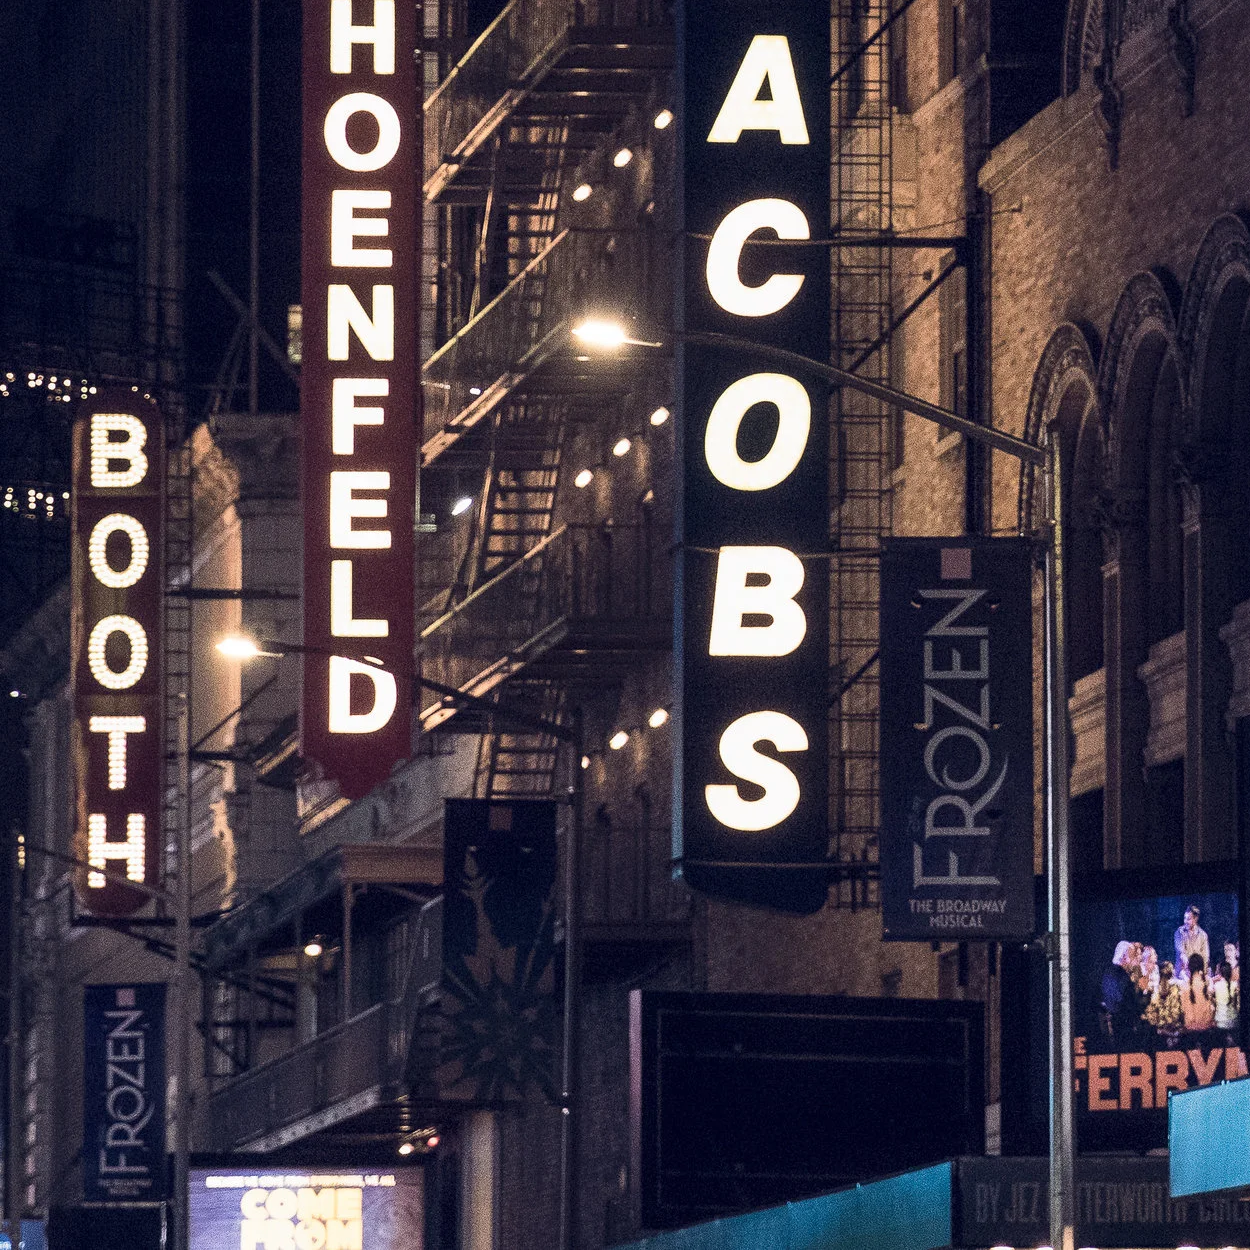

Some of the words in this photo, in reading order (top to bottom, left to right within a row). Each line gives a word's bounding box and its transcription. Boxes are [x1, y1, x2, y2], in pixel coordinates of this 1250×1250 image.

[86, 413, 149, 889] BOOTH
[912, 588, 1009, 890] FROZEN
[908, 898, 934, 914] THE
[936, 898, 1008, 914] BROADWAY
[929, 914, 985, 928] MUSICAL
[100, 1009, 155, 1174] FROZEN
[239, 1187, 364, 1220] COME
[975, 1182, 1001, 1223] BY
[1004, 1182, 1041, 1223] JEZ
